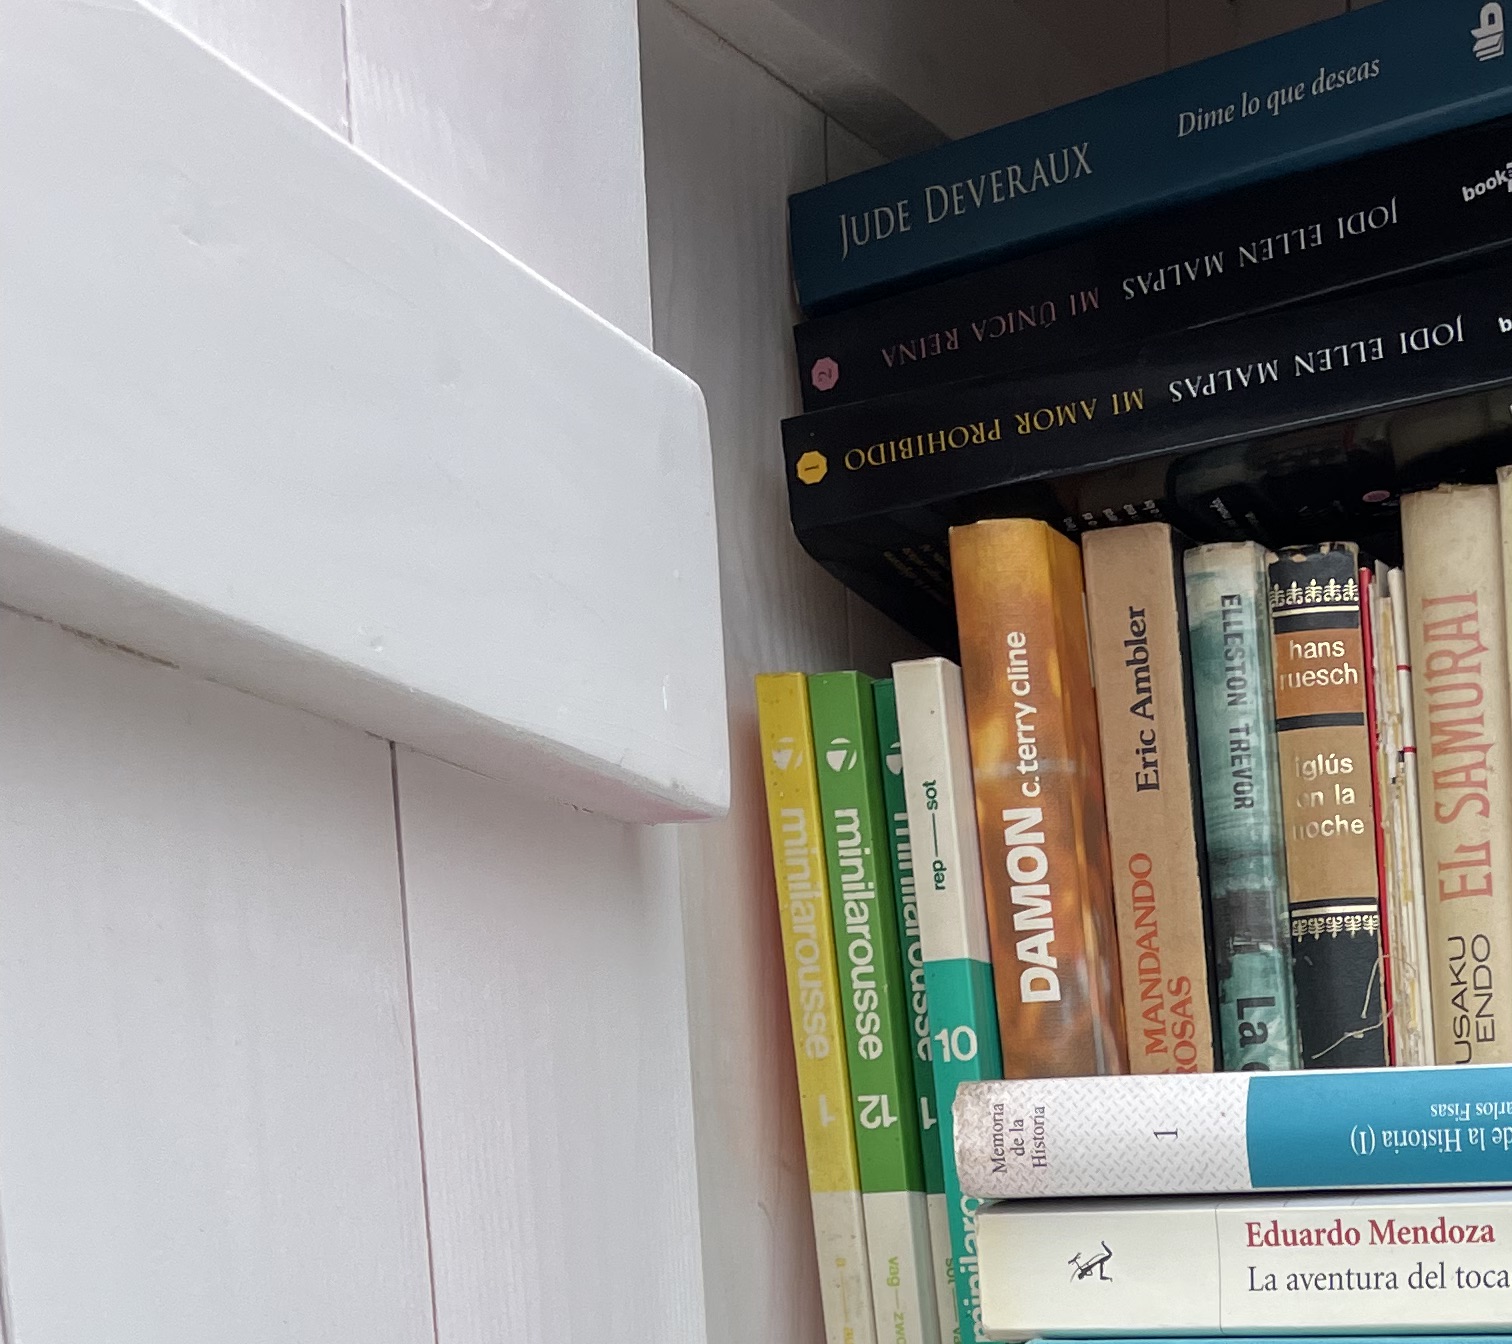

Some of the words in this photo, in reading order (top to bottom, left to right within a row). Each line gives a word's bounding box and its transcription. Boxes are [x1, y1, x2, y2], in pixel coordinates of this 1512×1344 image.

[1176, 101, 1234, 139] Dime
[1240, 93, 1261, 120] lo
[1267, 79, 1305, 118] que
[1311, 57, 1381, 98] deseas
[837, 200, 913, 261] JUDE
[923, 142, 1094, 226] DEVERAUX
[1294, 336, 1386, 375] ELLEN
[1397, 316, 1465, 353] JODI
[1111, 388, 1145, 411] MI
[1168, 359, 1280, 402] MALPAS
[845, 419, 1001, 472] PROHIBIDO
[1016, 399, 1097, 435] AMOR
[1006, 631, 1029, 695] cline
[1124, 606, 1154, 721] Ambler
[1219, 594, 1249, 708] ELLESTON
[1004, 701, 1038, 774] terry
[1421, 591, 1492, 824] SAMURAI
[1135, 727, 1161, 794] Eric
[1226, 725, 1254, 811] TREVOR
[1439, 843, 1494, 903] EL
[833, 808, 883, 1060] minilarousse
[1002, 808, 1062, 1003] DAMON
[1471, 934, 1495, 1043] ENDO
[935, 1026, 977, 1062] 10
[858, 1094, 897, 1129] 12
[991, 1102, 1006, 1175] Memoria
[1032, 1105, 1048, 1169] Historia
[1382, 1125, 1463, 1153] Historia
[1430, 1102, 1473, 1121] Fisas
[1246, 1220, 1362, 1249] Eduardo
[1368, 1219, 1495, 1247] Mendoza
[1248, 1266, 1279, 1292] La
[1285, 1267, 1401, 1292] aventura
[1409, 1263, 1447, 1290] del
